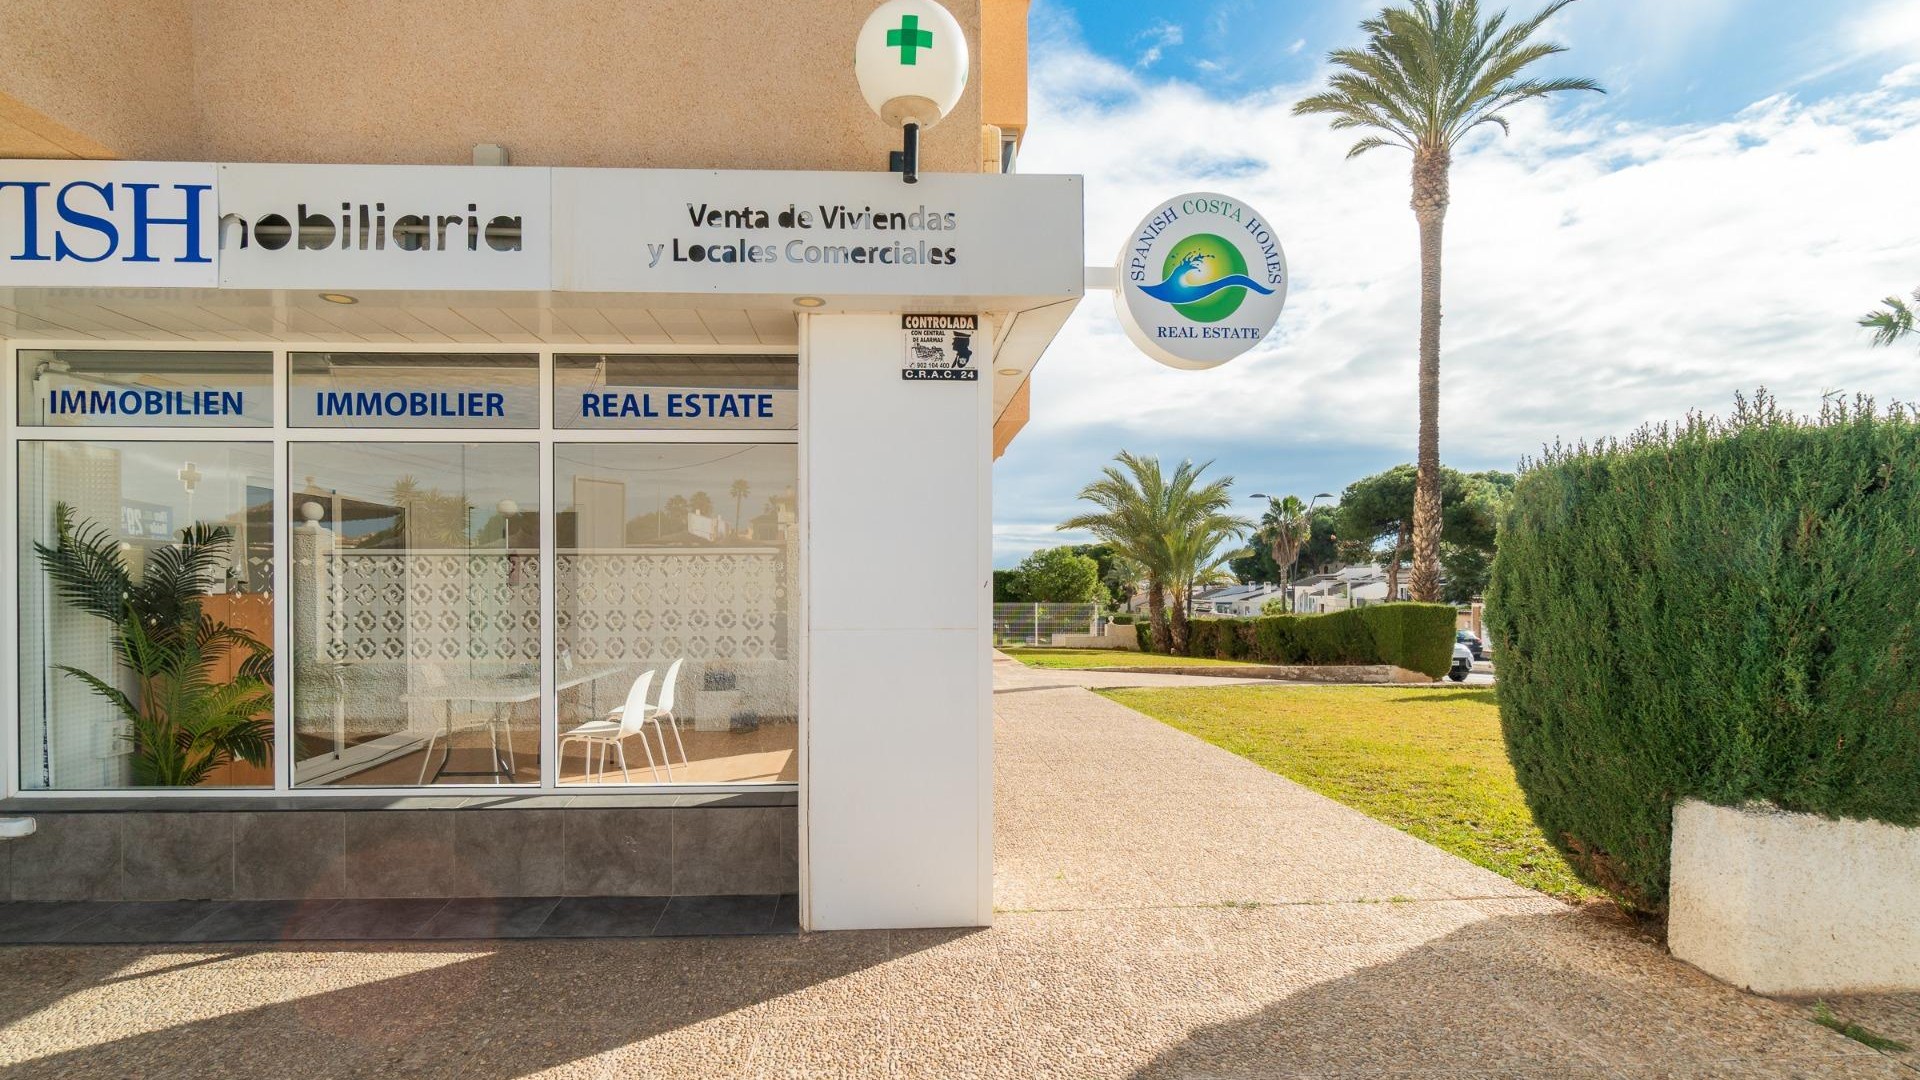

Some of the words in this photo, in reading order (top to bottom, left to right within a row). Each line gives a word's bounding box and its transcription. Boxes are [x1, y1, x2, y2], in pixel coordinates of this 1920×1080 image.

[0, 181, 212, 262] ISH
[687, 203, 769, 229] Venta
[778, 204, 813, 229] de
[819, 205, 957, 231] Viviendas
[647, 243, 664, 268] y
[673, 238, 777, 263] Locales
[785, 239, 957, 265] Comerciales
[1131, 206, 1178, 281] SPANISH
[1183, 198, 1242, 223] COSTA
[1245, 218, 1281, 284] HOMES
[905, 316, 974, 329] CONTROLADA
[1157, 326, 1198, 339] REAL
[1202, 327, 1260, 339] ESTATE
[905, 370, 956, 379] C.R.A.C.
[960, 370, 974, 379] 24
[49, 390, 244, 416] IMMOBILIEN
[317, 392, 505, 417] IMMOBILIER
[582, 393, 659, 417] REAL
[667, 394, 773, 418] ESTATE
